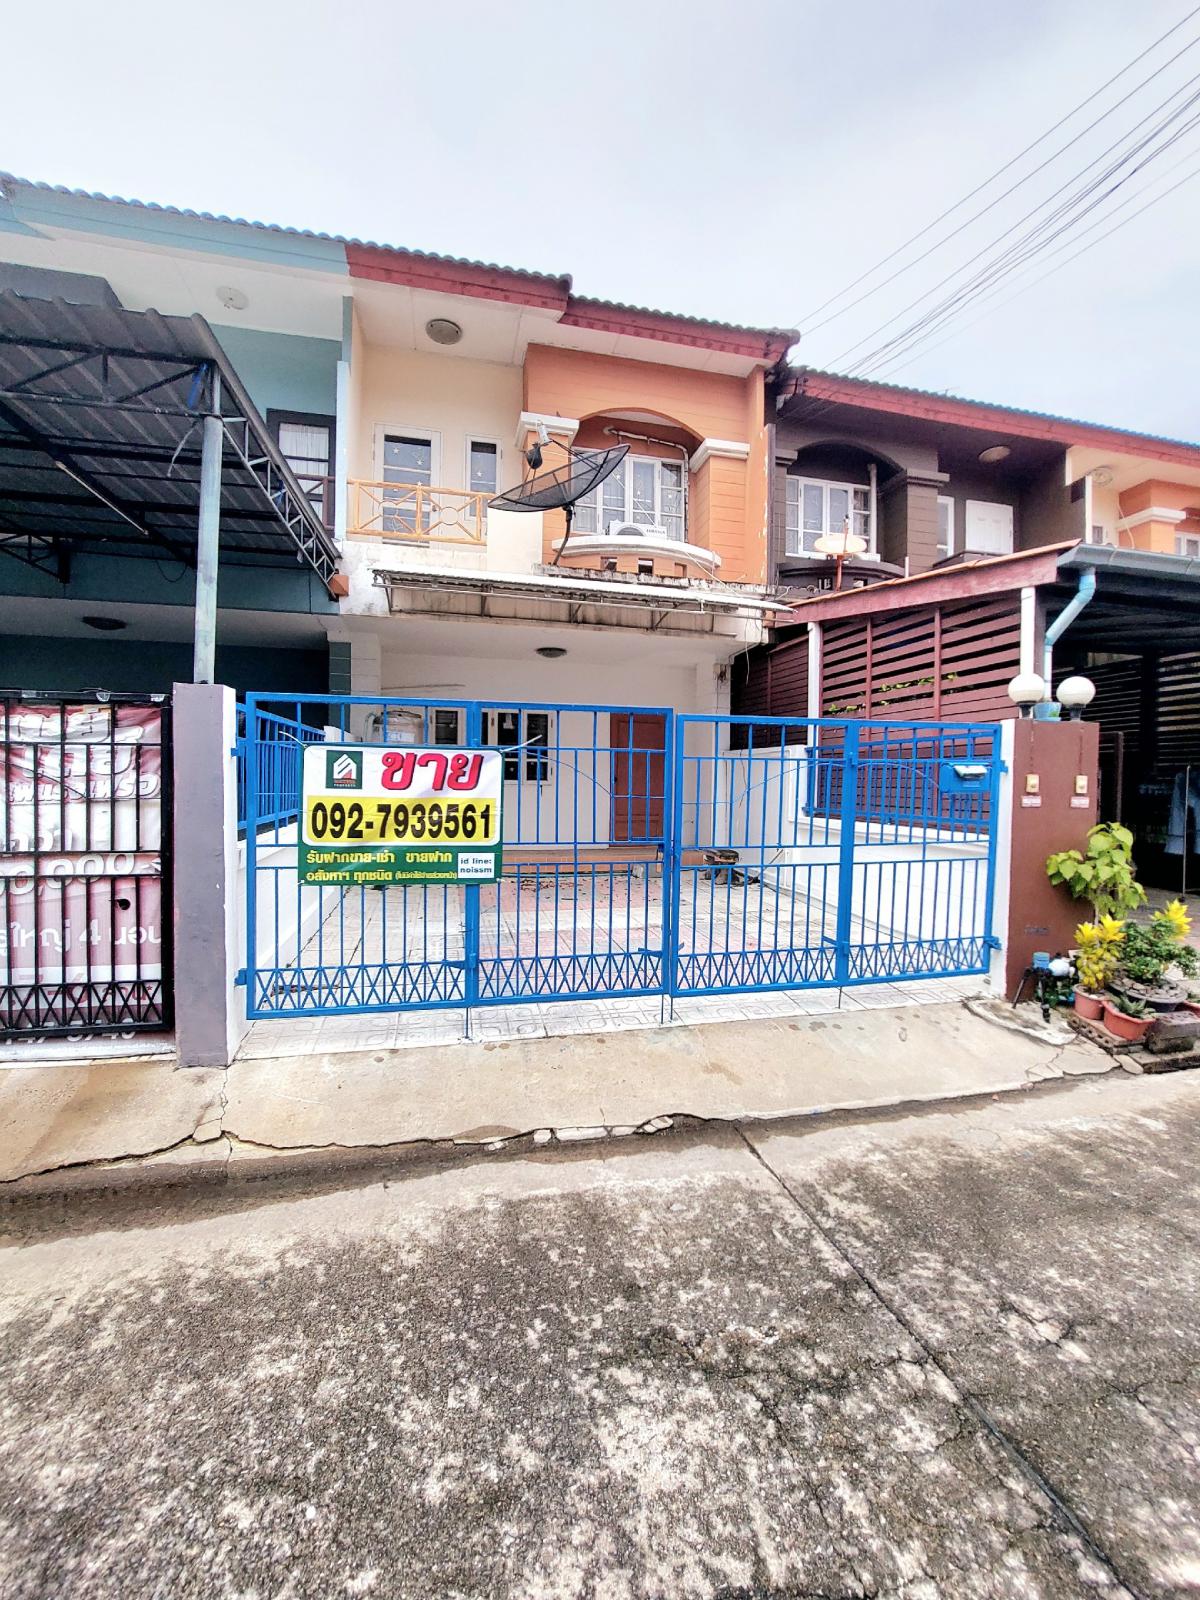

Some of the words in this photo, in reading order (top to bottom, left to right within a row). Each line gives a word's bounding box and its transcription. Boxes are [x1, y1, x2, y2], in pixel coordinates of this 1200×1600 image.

[381, 752, 485, 791] ขาย
[311, 802, 491, 839] 092-7939561
[405, 850, 453, 863] ขายฝาก
[460, 857, 469, 865] id
